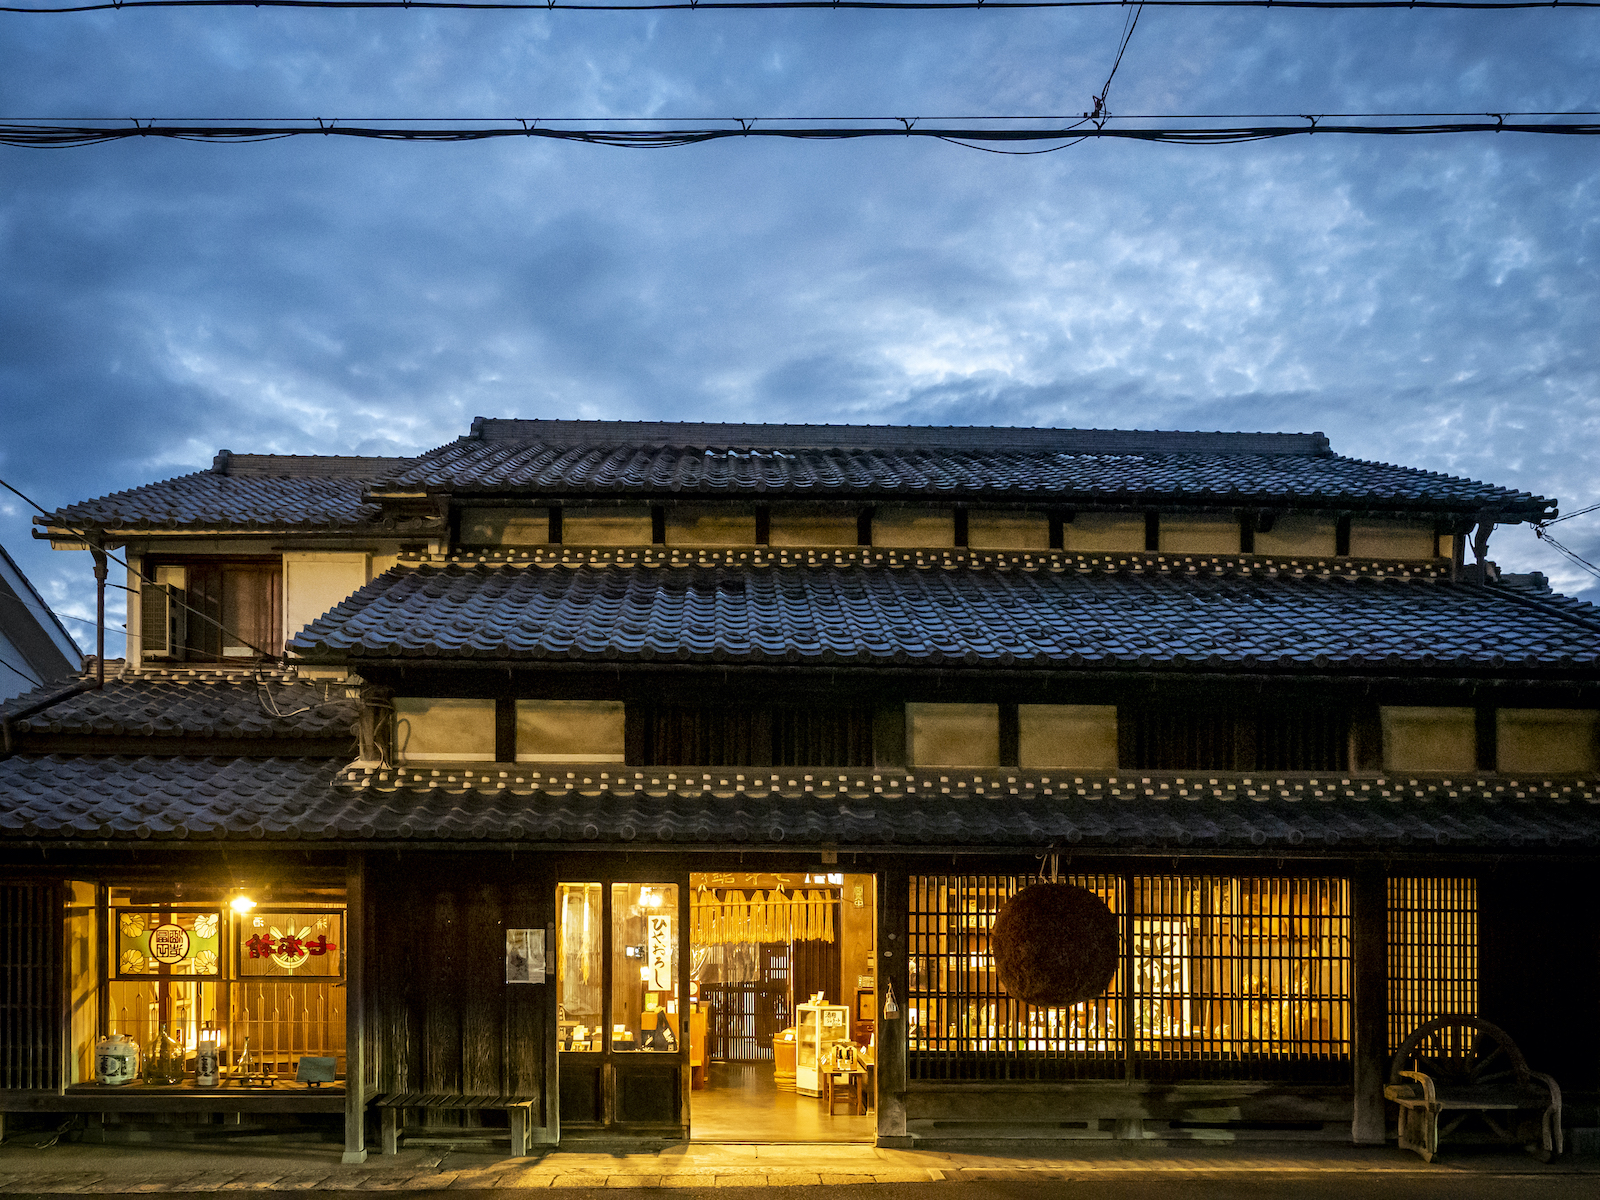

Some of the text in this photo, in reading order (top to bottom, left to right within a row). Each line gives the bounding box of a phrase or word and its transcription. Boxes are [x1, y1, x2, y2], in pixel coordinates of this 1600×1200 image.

[651, 918, 668, 988] ひやおろし
